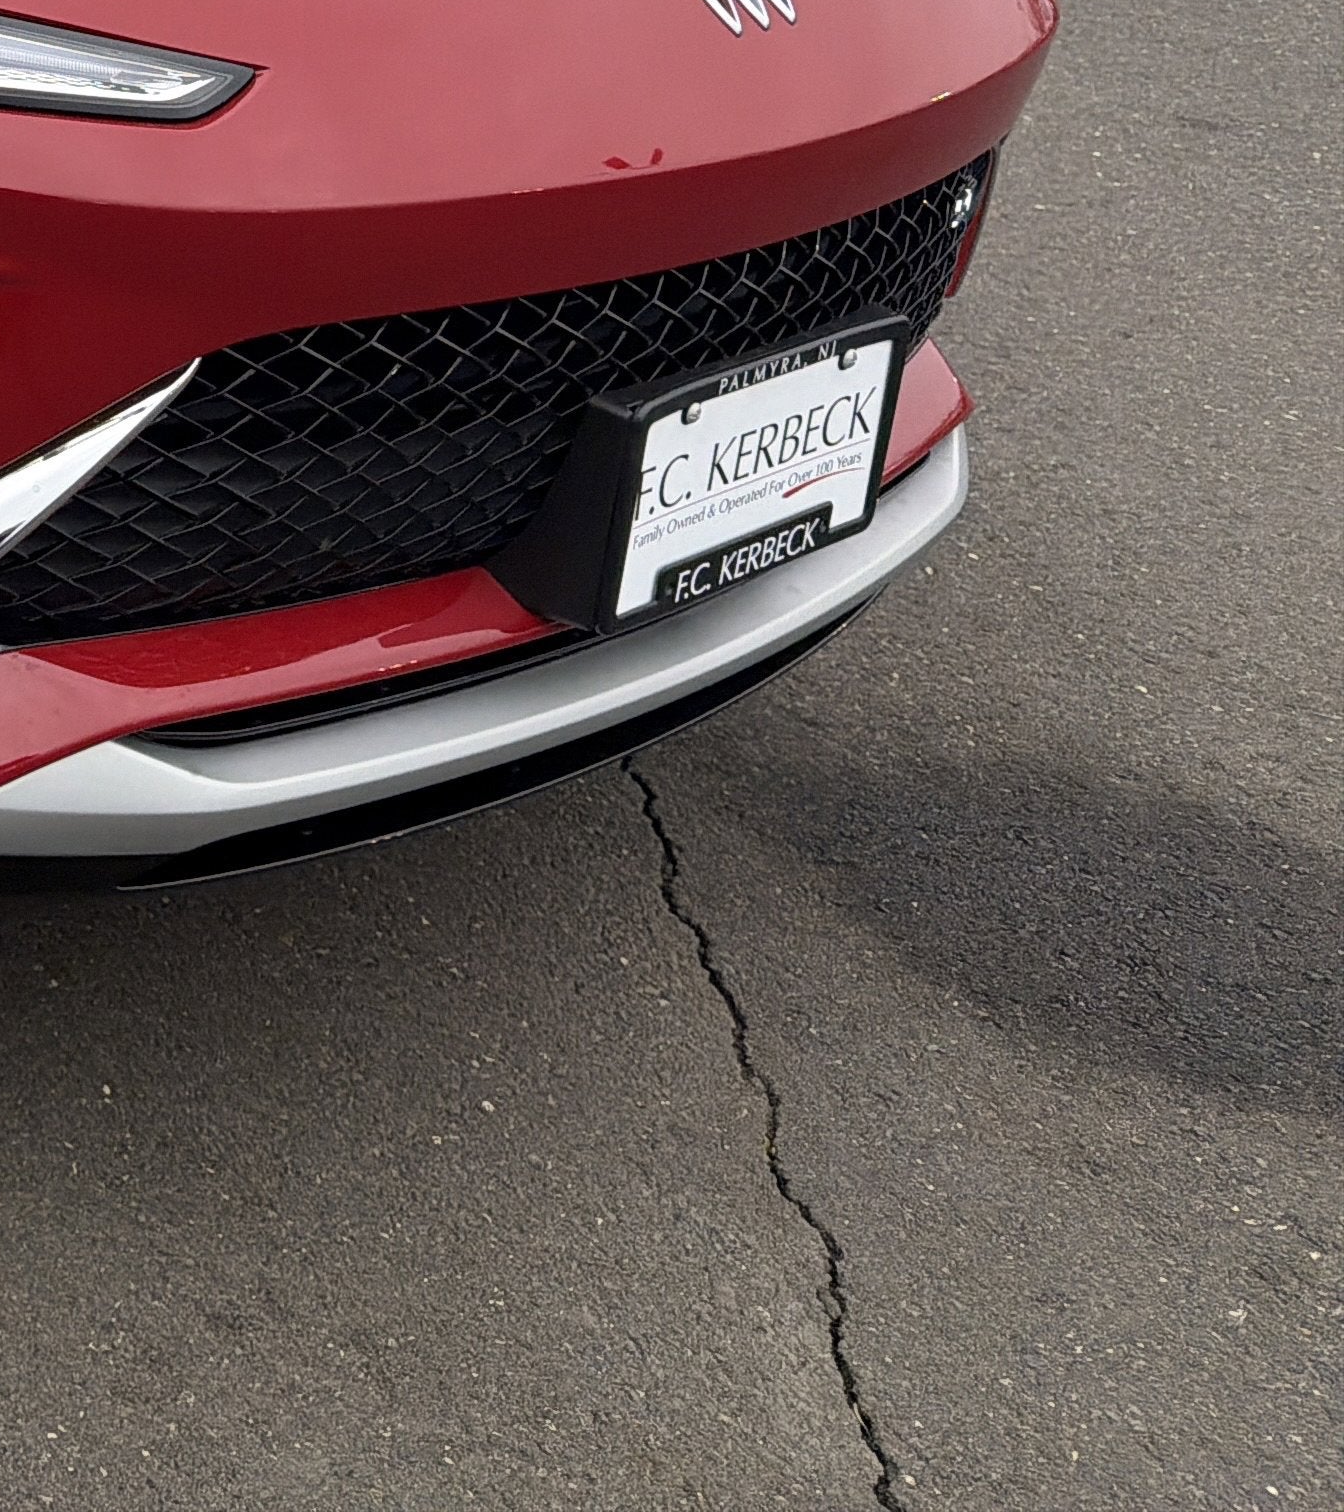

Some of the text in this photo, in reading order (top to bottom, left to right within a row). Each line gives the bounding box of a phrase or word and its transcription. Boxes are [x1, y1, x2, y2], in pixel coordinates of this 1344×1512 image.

[633, 451, 863, 550] Family Owned & Operated For Over 100 Years
[634, 386, 877, 522] F.C. KERBECK
[673, 517, 821, 604] F.C. KERBECK
